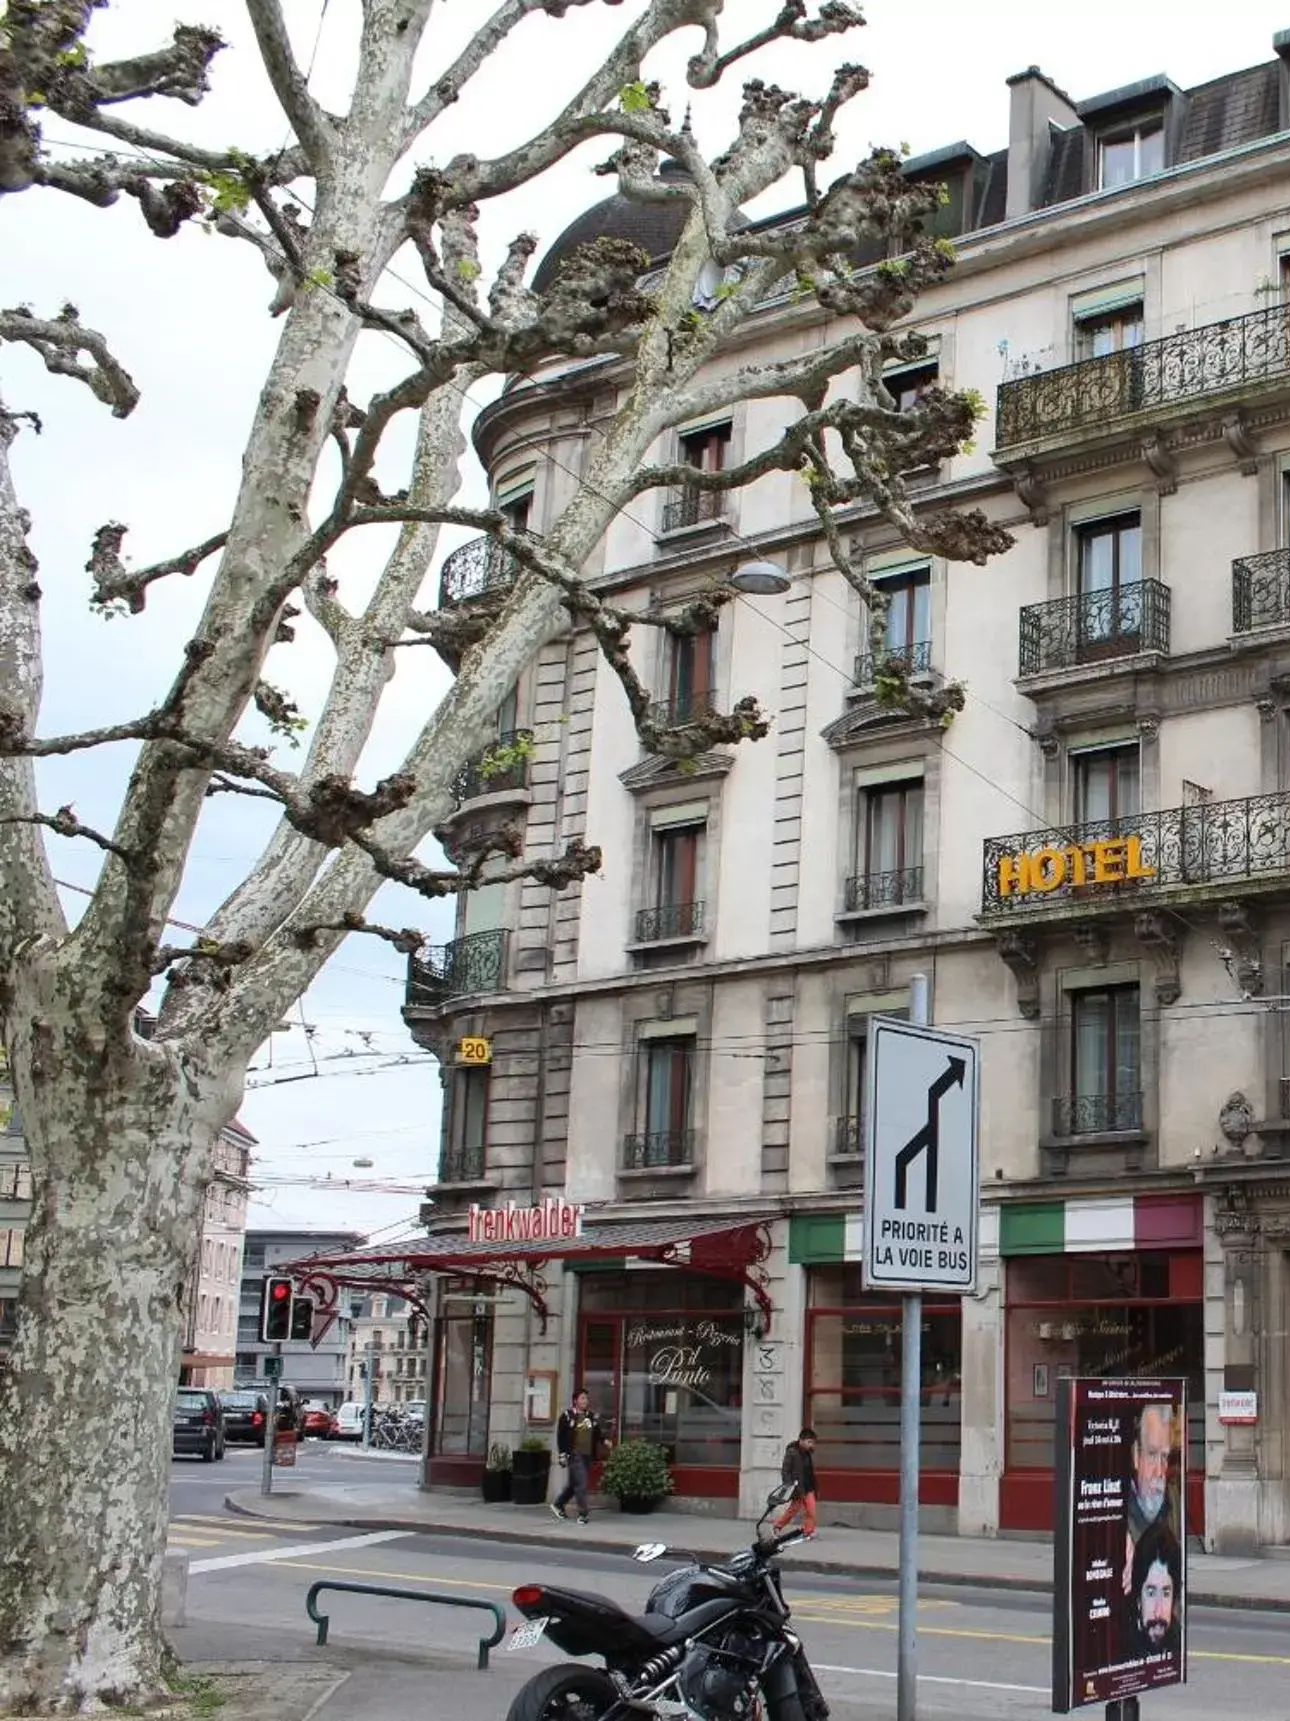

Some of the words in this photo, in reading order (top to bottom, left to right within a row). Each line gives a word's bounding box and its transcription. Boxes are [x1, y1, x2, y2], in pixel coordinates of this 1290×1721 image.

[998, 835, 1156, 898] HOTEL
[464, 1043, 485, 1059] 20
[468, 1199, 583, 1243] trenkwalder
[881, 1219, 949, 1244] PRIORITÉ
[954, 1226, 963, 1244] A
[875, 1246, 893, 1266] LA
[898, 1247, 933, 1268] VOIE
[938, 1250, 967, 1271] BUS
